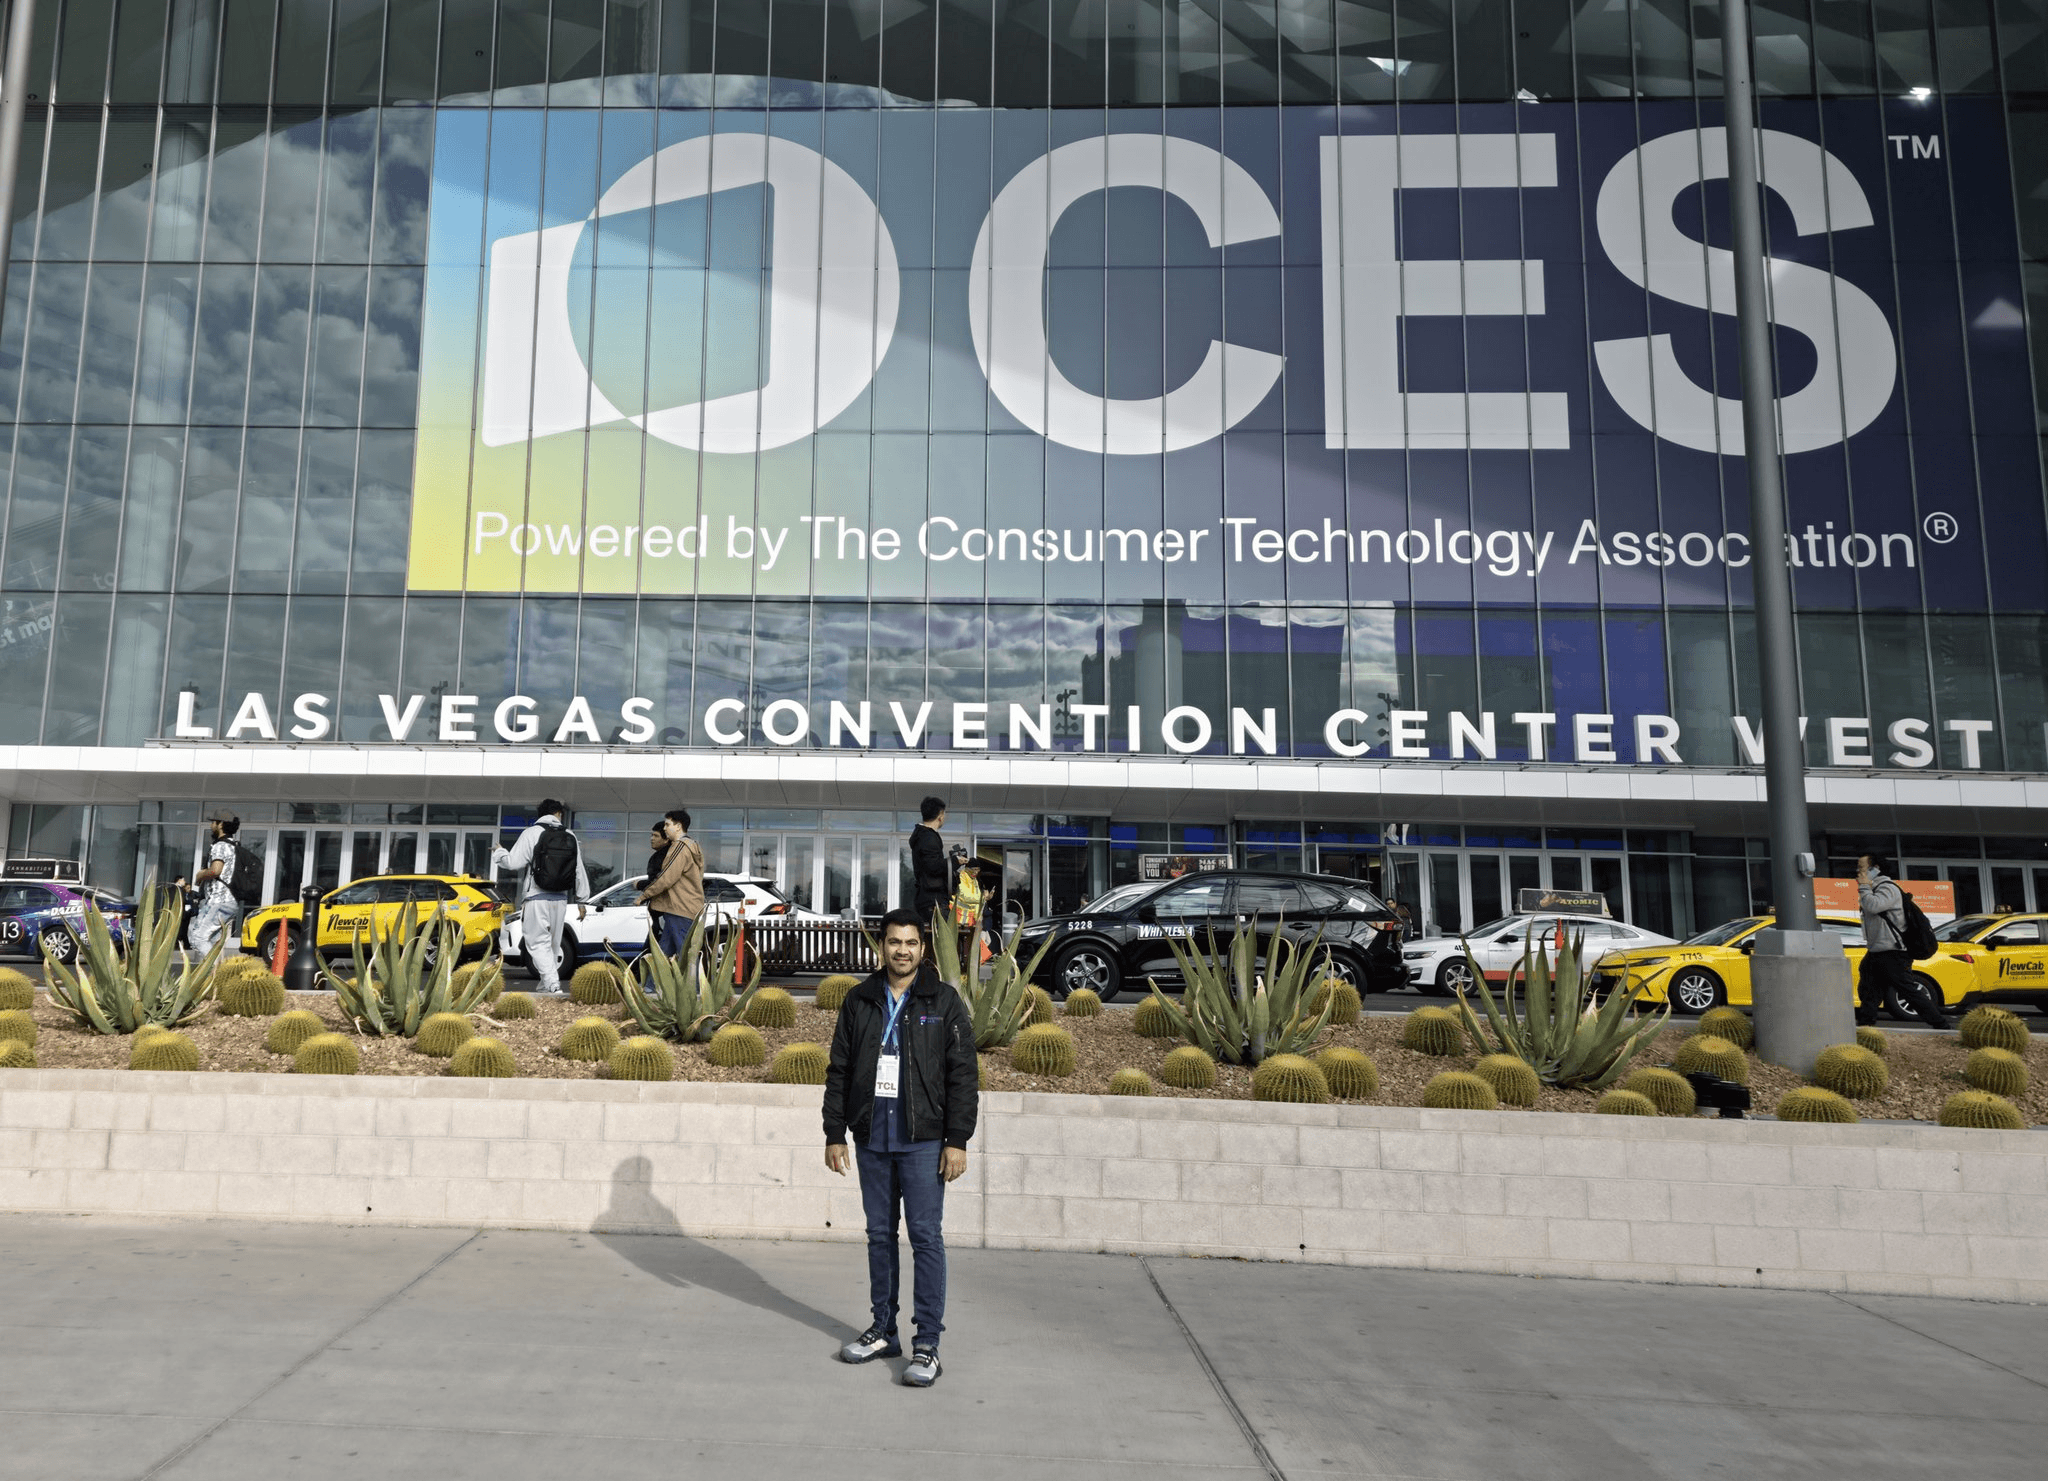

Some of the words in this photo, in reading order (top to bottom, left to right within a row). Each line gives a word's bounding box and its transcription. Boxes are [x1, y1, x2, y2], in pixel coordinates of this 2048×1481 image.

[968, 127, 1898, 457] CES
[474, 511, 708, 558] Powered
[728, 515, 789, 571] by
[800, 516, 901, 560] The
[917, 516, 1209, 562] Consumer
[1219, 517, 1555, 577] Technology
[1567, 519, 1915, 567] Assocation
[175, 691, 331, 740] LAS
[378, 694, 657, 744] VEGAS
[703, 698, 1277, 755] CONVENTION
[1323, 708, 1684, 763] CENTER
[1559, 898, 1600, 906] ATOMIC
[1068, 920, 1093, 931] 5228
[1679, 952, 1704, 961] 7713
[876, 1081, 897, 1091] TCL
